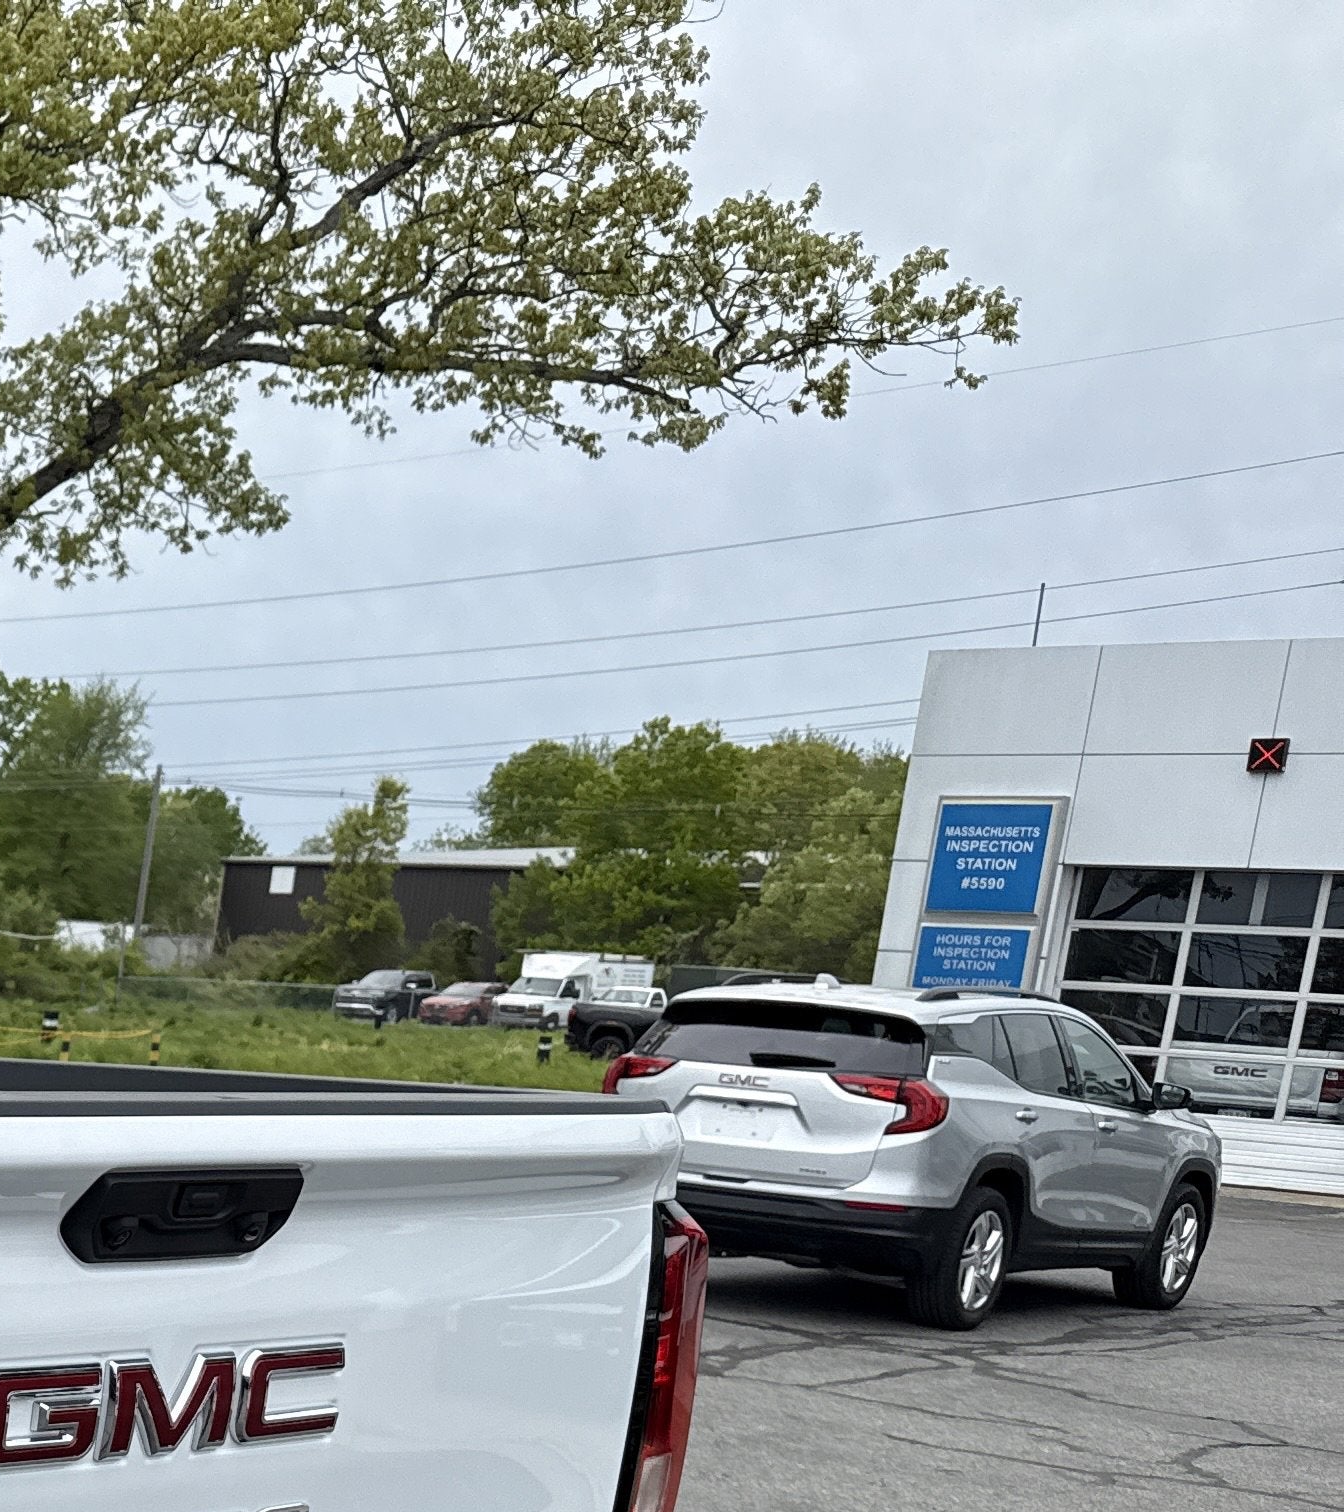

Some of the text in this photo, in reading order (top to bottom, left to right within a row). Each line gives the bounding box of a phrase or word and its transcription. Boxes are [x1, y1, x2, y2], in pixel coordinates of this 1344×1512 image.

[944, 826, 1041, 838] MASSACHUSETTS
[945, 840, 1034, 853] INSPECTION
[955, 858, 1017, 871] STATION
[960, 877, 1005, 890] #5590
[935, 934, 1011, 947] HOURS FOR
[933, 947, 1010, 960] INSPECTION
[942, 959, 996, 972] STATION
[1213, 1065, 1268, 1078] GMC
[718, 1072, 771, 1089] GMC
